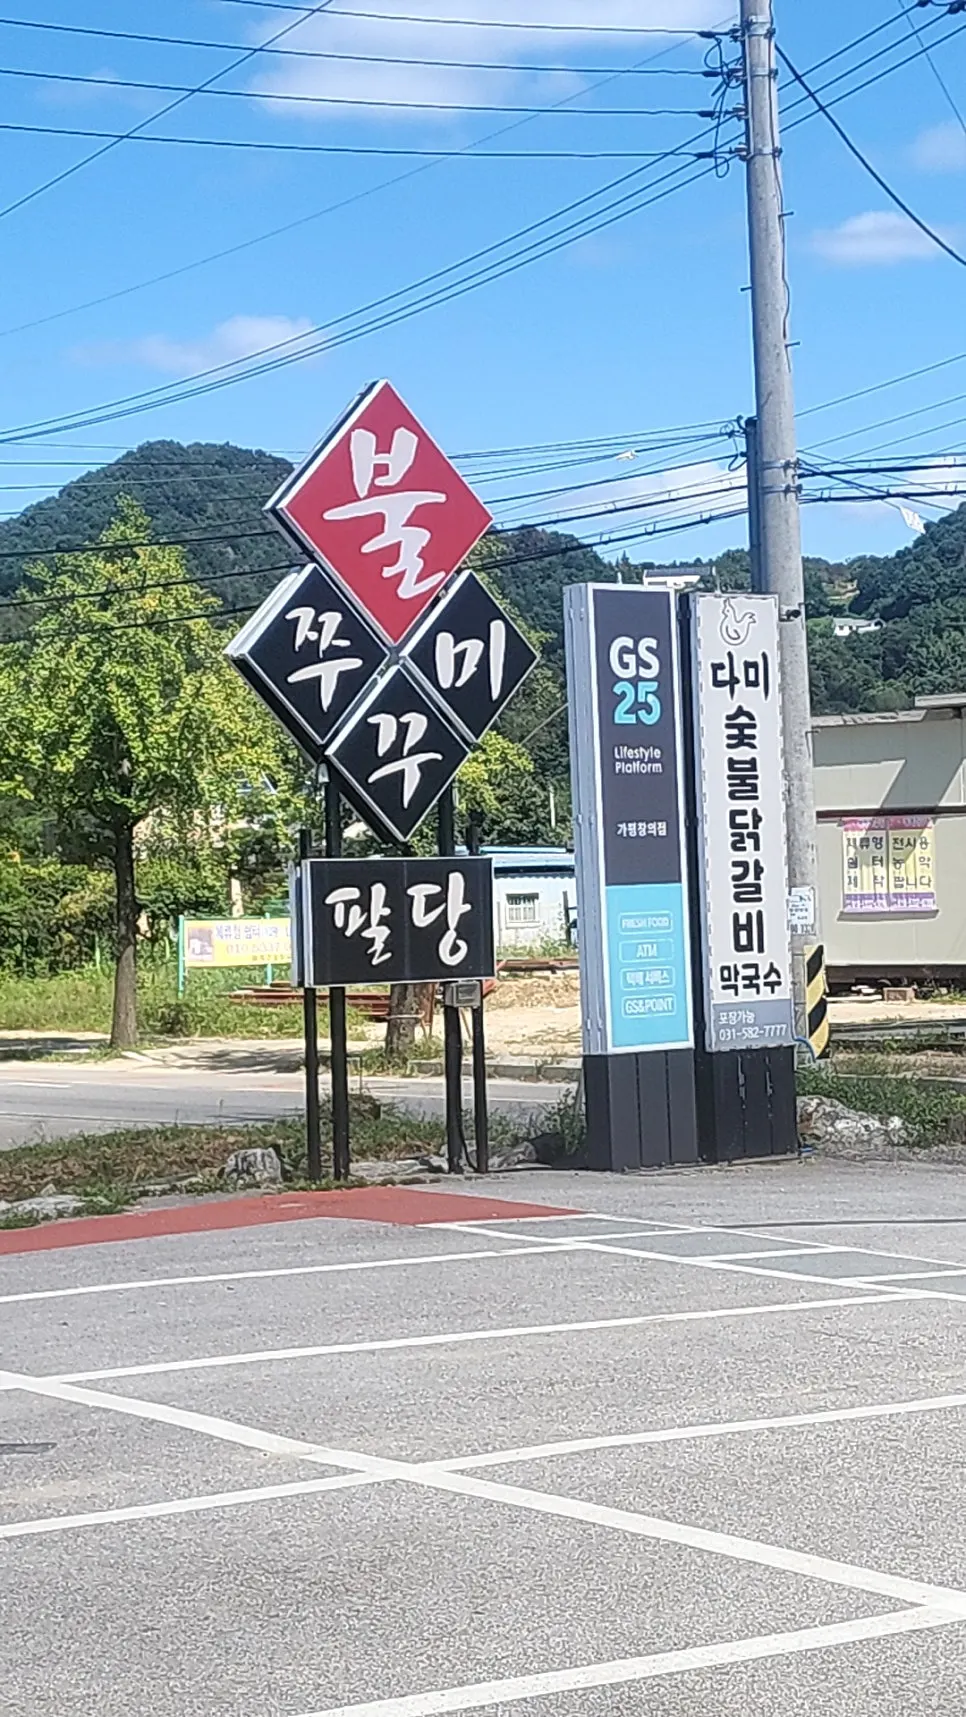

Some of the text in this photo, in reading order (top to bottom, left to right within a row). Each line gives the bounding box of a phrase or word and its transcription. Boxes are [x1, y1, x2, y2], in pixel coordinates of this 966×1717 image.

[322, 426, 447, 599] 불
[285, 606, 363, 712] 쭈
[434, 619, 506, 700] 미
[609, 636, 660, 679] GS
[710, 651, 770, 701] 다미
[612, 681, 661, 725] 25
[367, 711, 444, 808] 꾸
[614, 746, 661, 762] Lifestyle
[615, 761, 663, 774] Platform
[324, 871, 472, 970] 팔당
[648, 917, 670, 927] FOOD
[636, 943, 657, 958] ATM
[720, 962, 782, 996] 막국수
[625, 996, 673, 1014] GS&POINT
[718, 1010, 755, 1025] 포장가능
[719, 1023, 787, 1041] 031-582-7777
